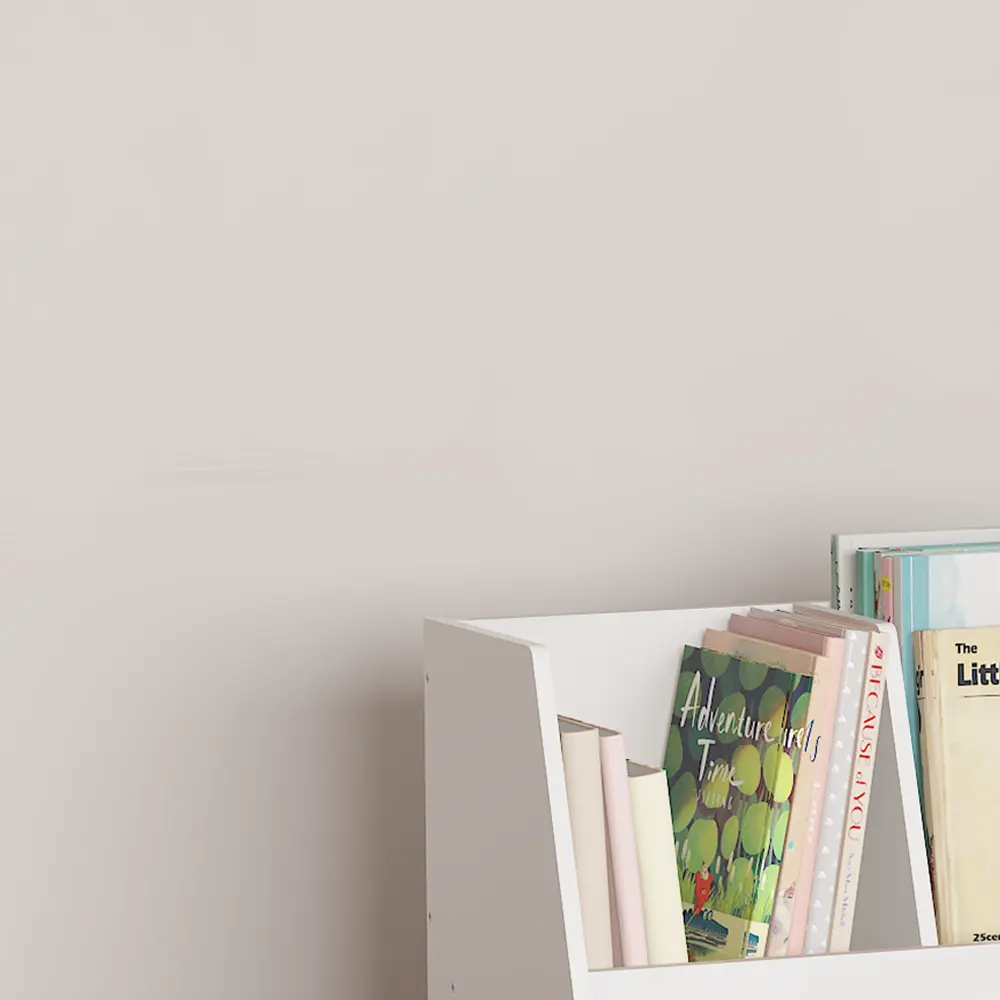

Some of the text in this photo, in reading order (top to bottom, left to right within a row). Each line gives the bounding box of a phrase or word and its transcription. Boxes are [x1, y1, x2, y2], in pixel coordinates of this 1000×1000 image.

[955, 643, 978, 654] The
[680, 670, 775, 742] Adventure
[697, 738, 744, 787] Time
[848, 792, 867, 841] YOU
